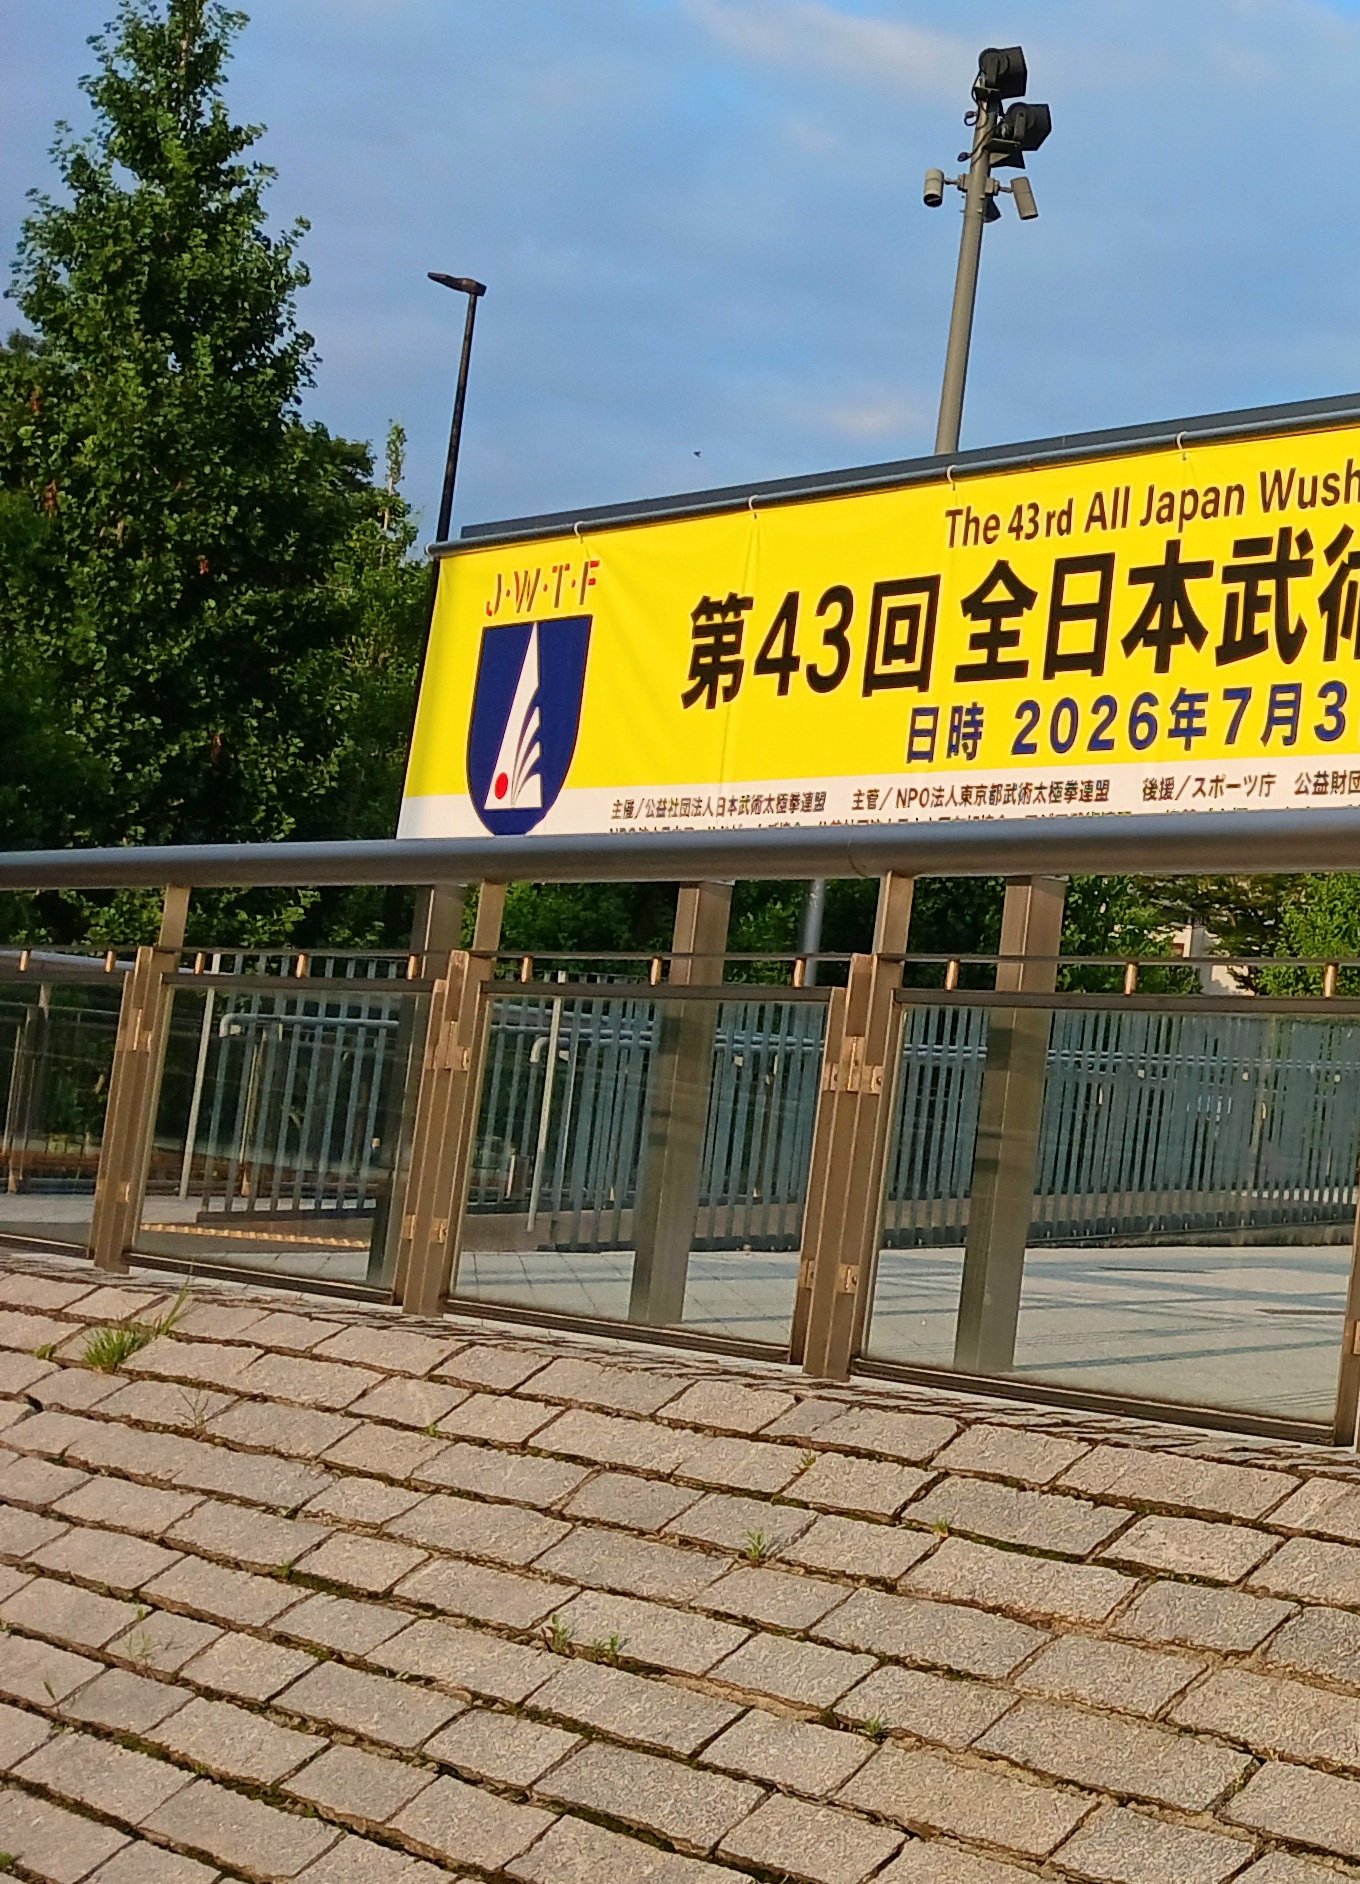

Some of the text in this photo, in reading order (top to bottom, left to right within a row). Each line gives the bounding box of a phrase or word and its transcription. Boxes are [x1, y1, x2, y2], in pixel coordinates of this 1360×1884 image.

[945, 507, 1001, 548] The
[1007, 497, 1073, 541] 43rd
[1084, 486, 1131, 533] All
[1139, 483, 1245, 533] Japan
[905, 701, 984, 764] 日時
